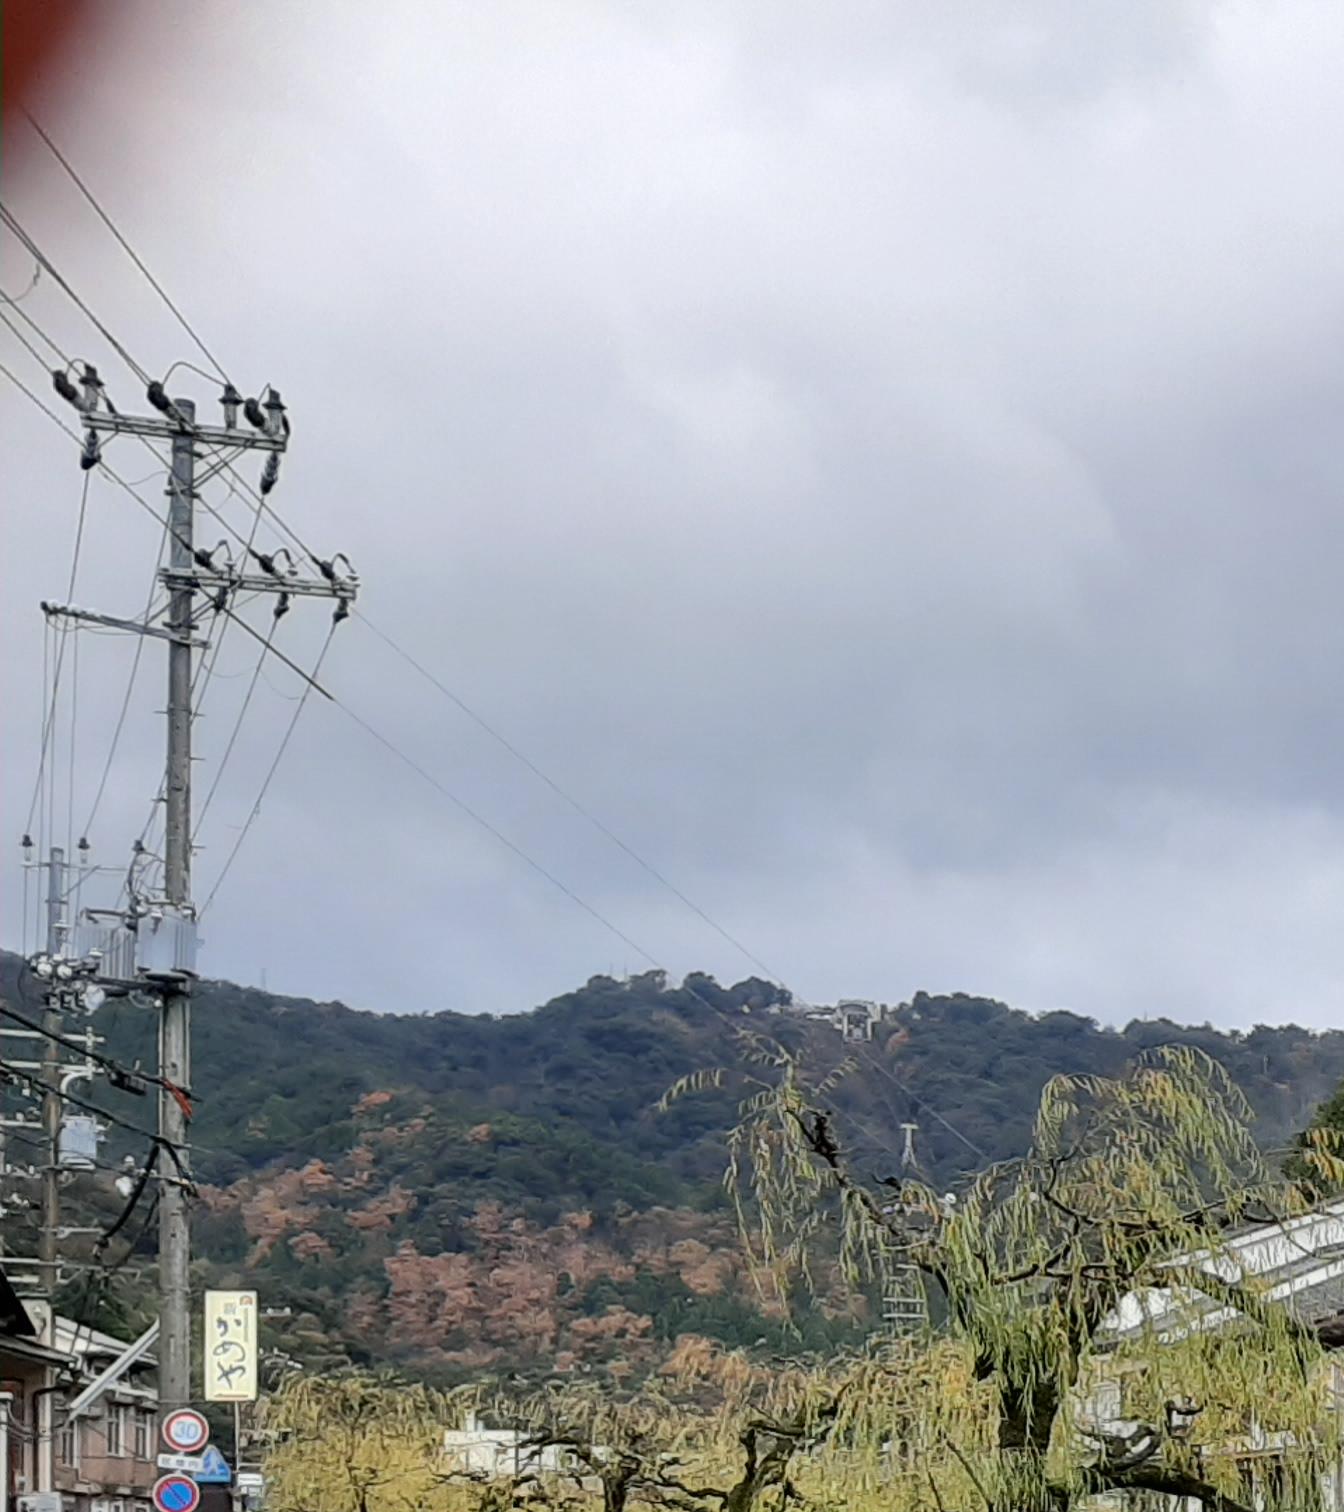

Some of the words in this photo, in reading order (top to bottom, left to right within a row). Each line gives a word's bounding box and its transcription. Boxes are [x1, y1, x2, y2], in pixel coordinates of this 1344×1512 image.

[213, 1316, 246, 1390] かめや
[173, 1420, 200, 1440] 30
